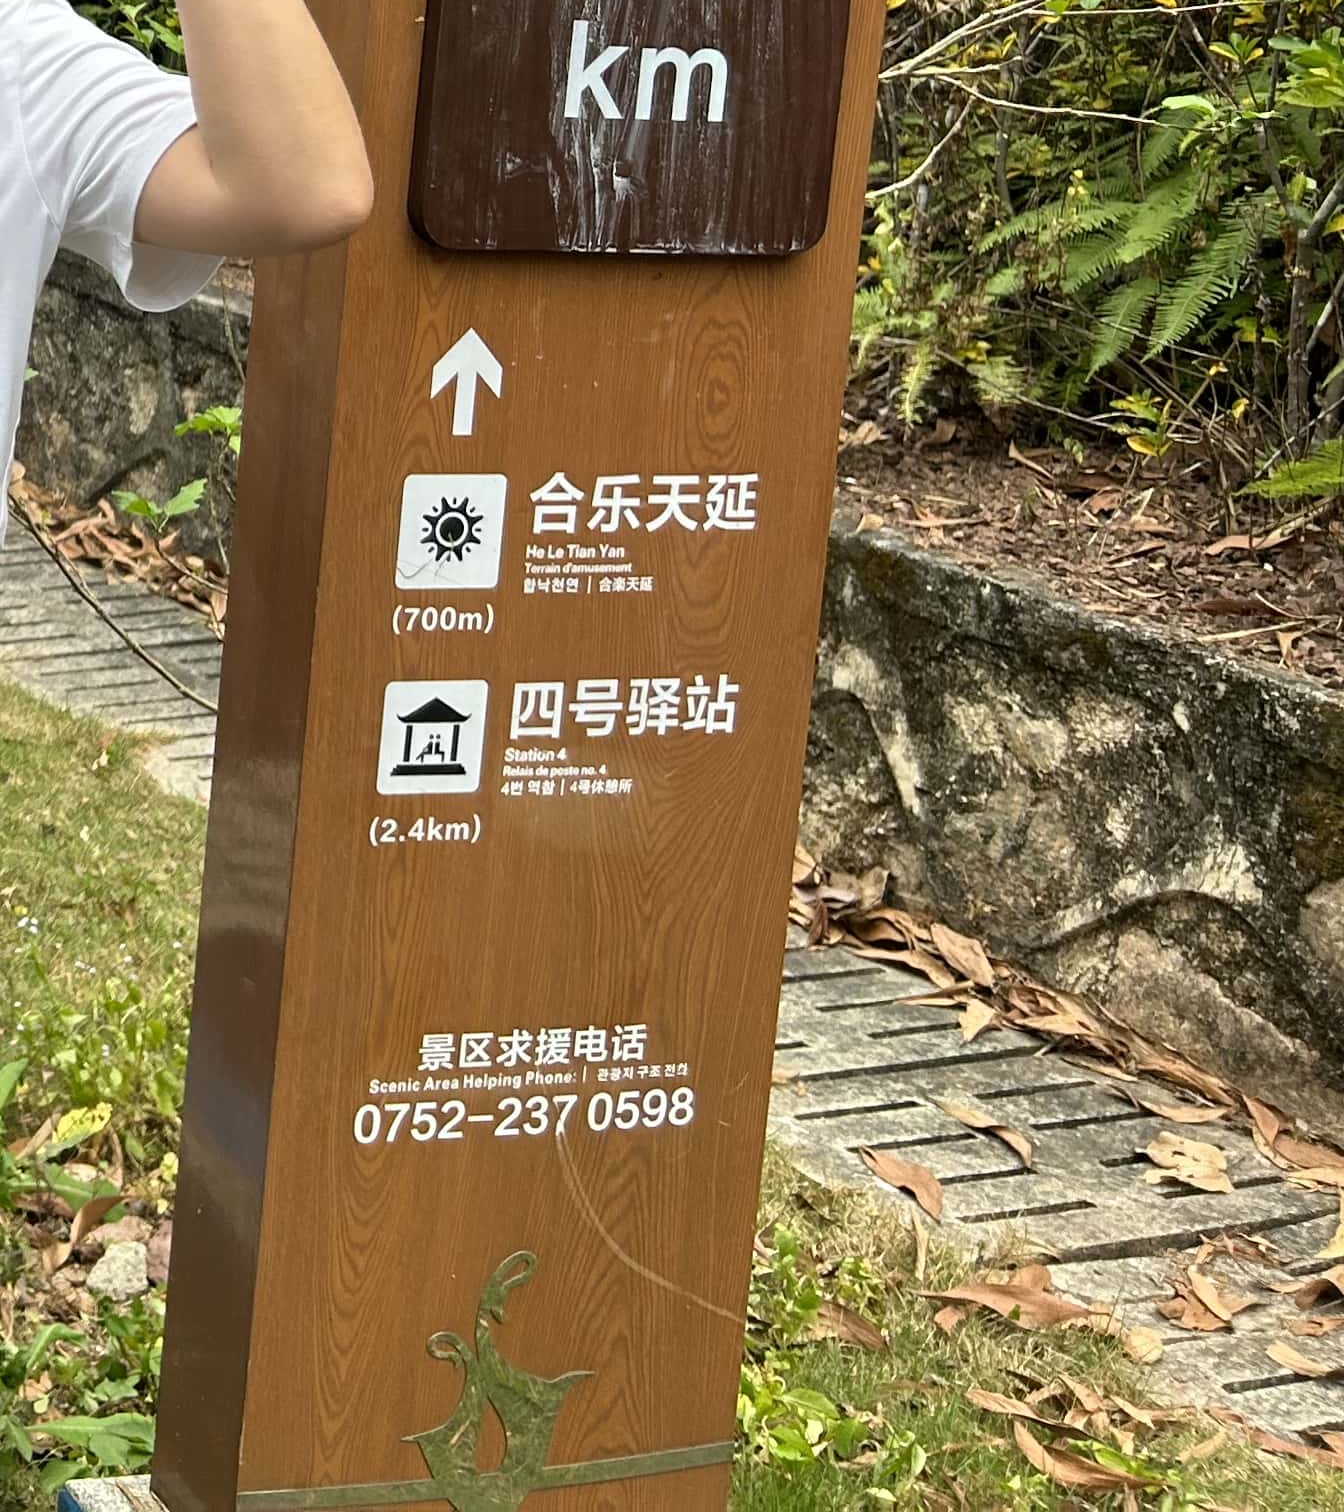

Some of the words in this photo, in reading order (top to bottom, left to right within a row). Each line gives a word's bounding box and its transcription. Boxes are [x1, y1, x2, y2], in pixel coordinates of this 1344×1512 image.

[564, 19, 728, 123] km
[529, 472, 760, 534] 合乐天延
[525, 544, 545, 559] He
[547, 544, 564, 559] Le
[566, 543, 596, 559] Tian
[599, 543, 625, 558] Yan
[525, 562, 560, 574] Terrain
[392, 603, 495, 635] (700m)
[509, 674, 740, 739] 四号驿站
[504, 747, 555, 762] Station
[557, 747, 567, 761] 4
[502, 765, 534, 777] Relais
[535, 765, 548, 776] de
[550, 766, 579, 778] poste
[599, 764, 607, 775] 4
[369, 814, 481, 846] (2.4km)
[418, 1024, 647, 1071] 景区求援电话
[369, 1077, 421, 1094] Scenic
[424, 1076, 459, 1091] Area
[463, 1073, 522, 1090] Helping
[525, 1071, 577, 1085] Phone:
[587, 1087, 694, 1131] 0598
